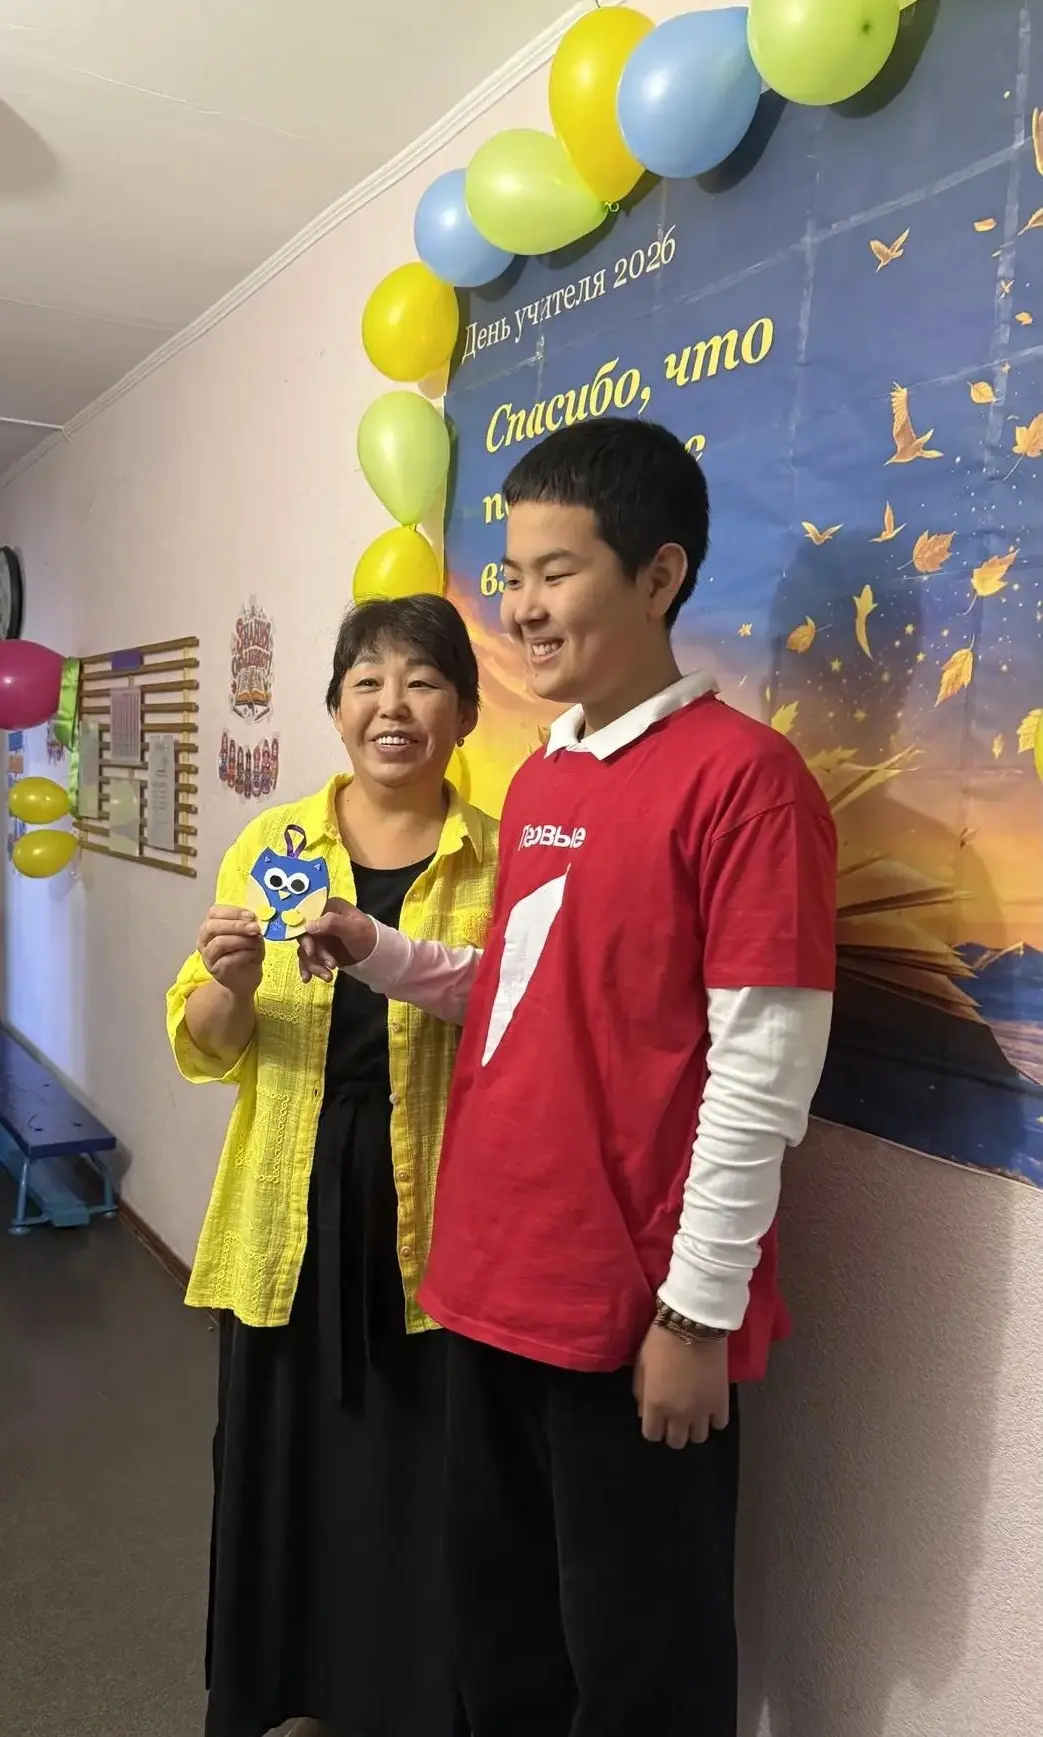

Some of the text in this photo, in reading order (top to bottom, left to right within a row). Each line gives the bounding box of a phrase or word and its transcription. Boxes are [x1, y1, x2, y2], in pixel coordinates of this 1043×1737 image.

[461, 224, 676, 364] День учителя 2026
[485, 317, 775, 455] Спасибо, что
